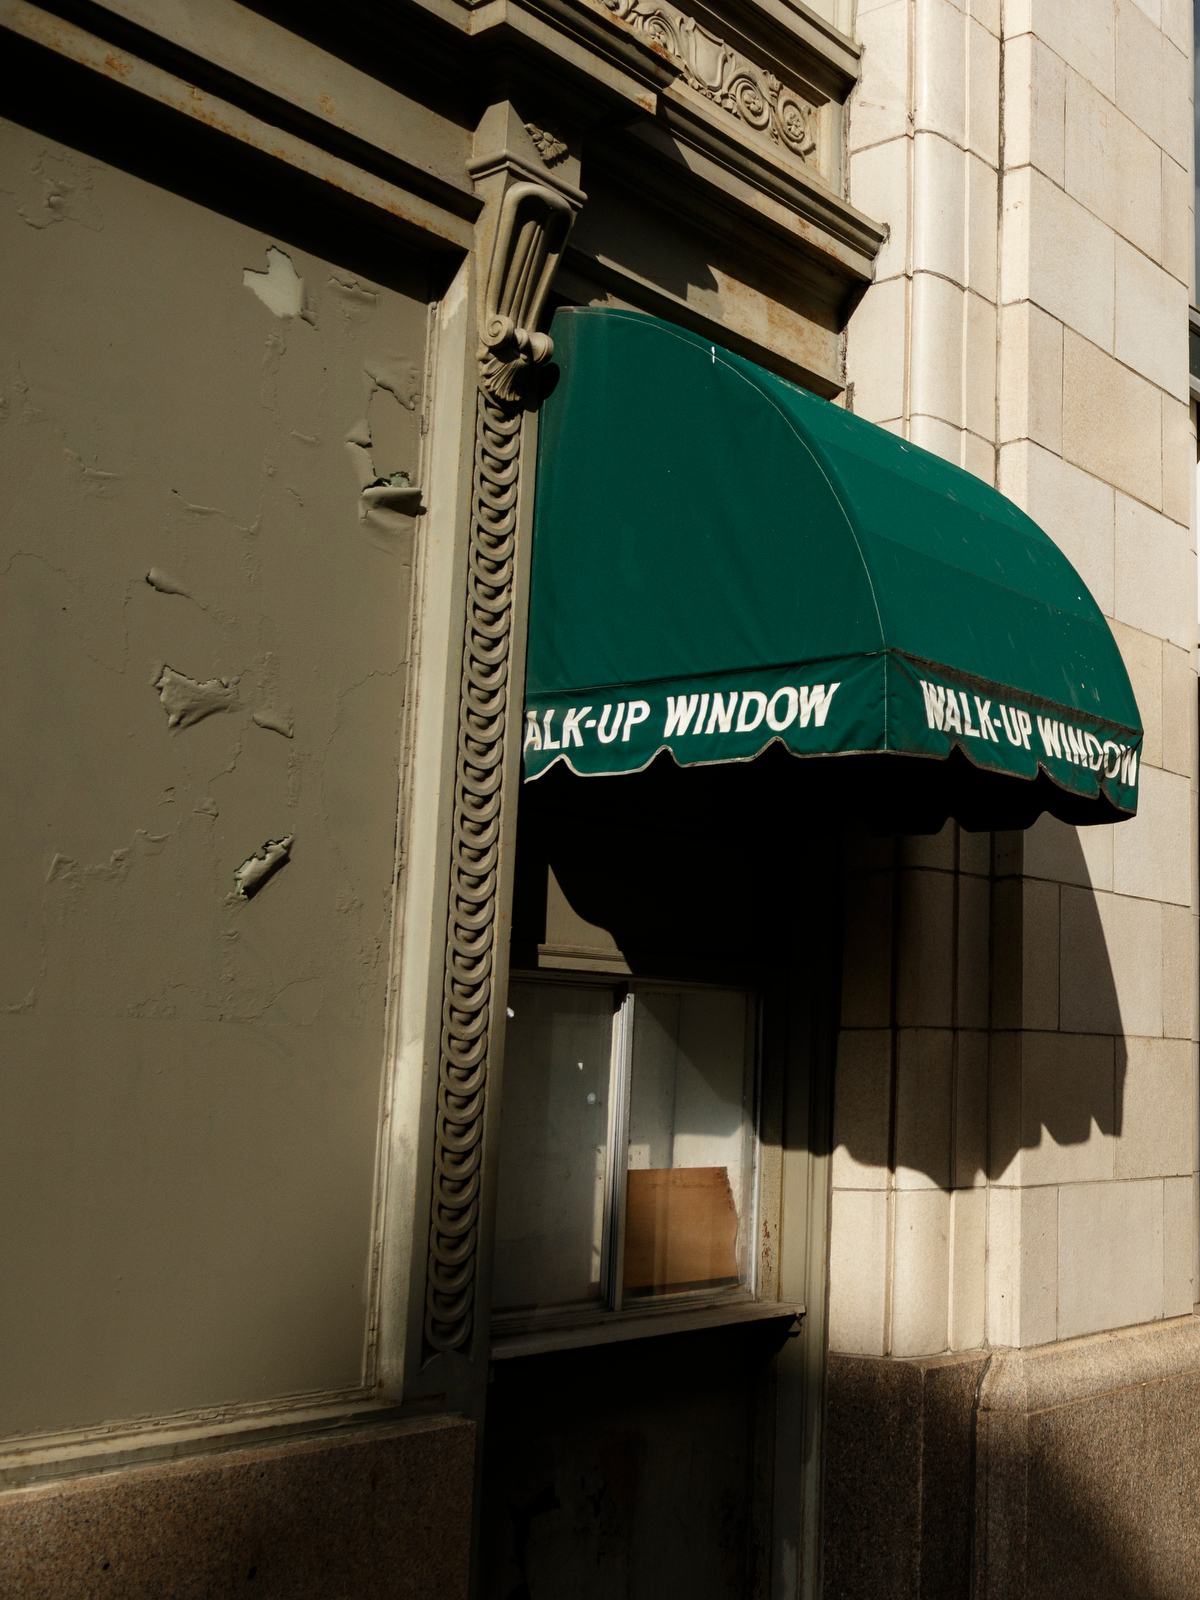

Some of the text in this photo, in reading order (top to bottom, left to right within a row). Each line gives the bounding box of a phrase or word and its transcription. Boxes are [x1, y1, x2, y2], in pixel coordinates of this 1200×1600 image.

[523, 682, 842, 752] ALK-UP WINDOW
[919, 680, 1138, 787] WALK-UP WINDOW
